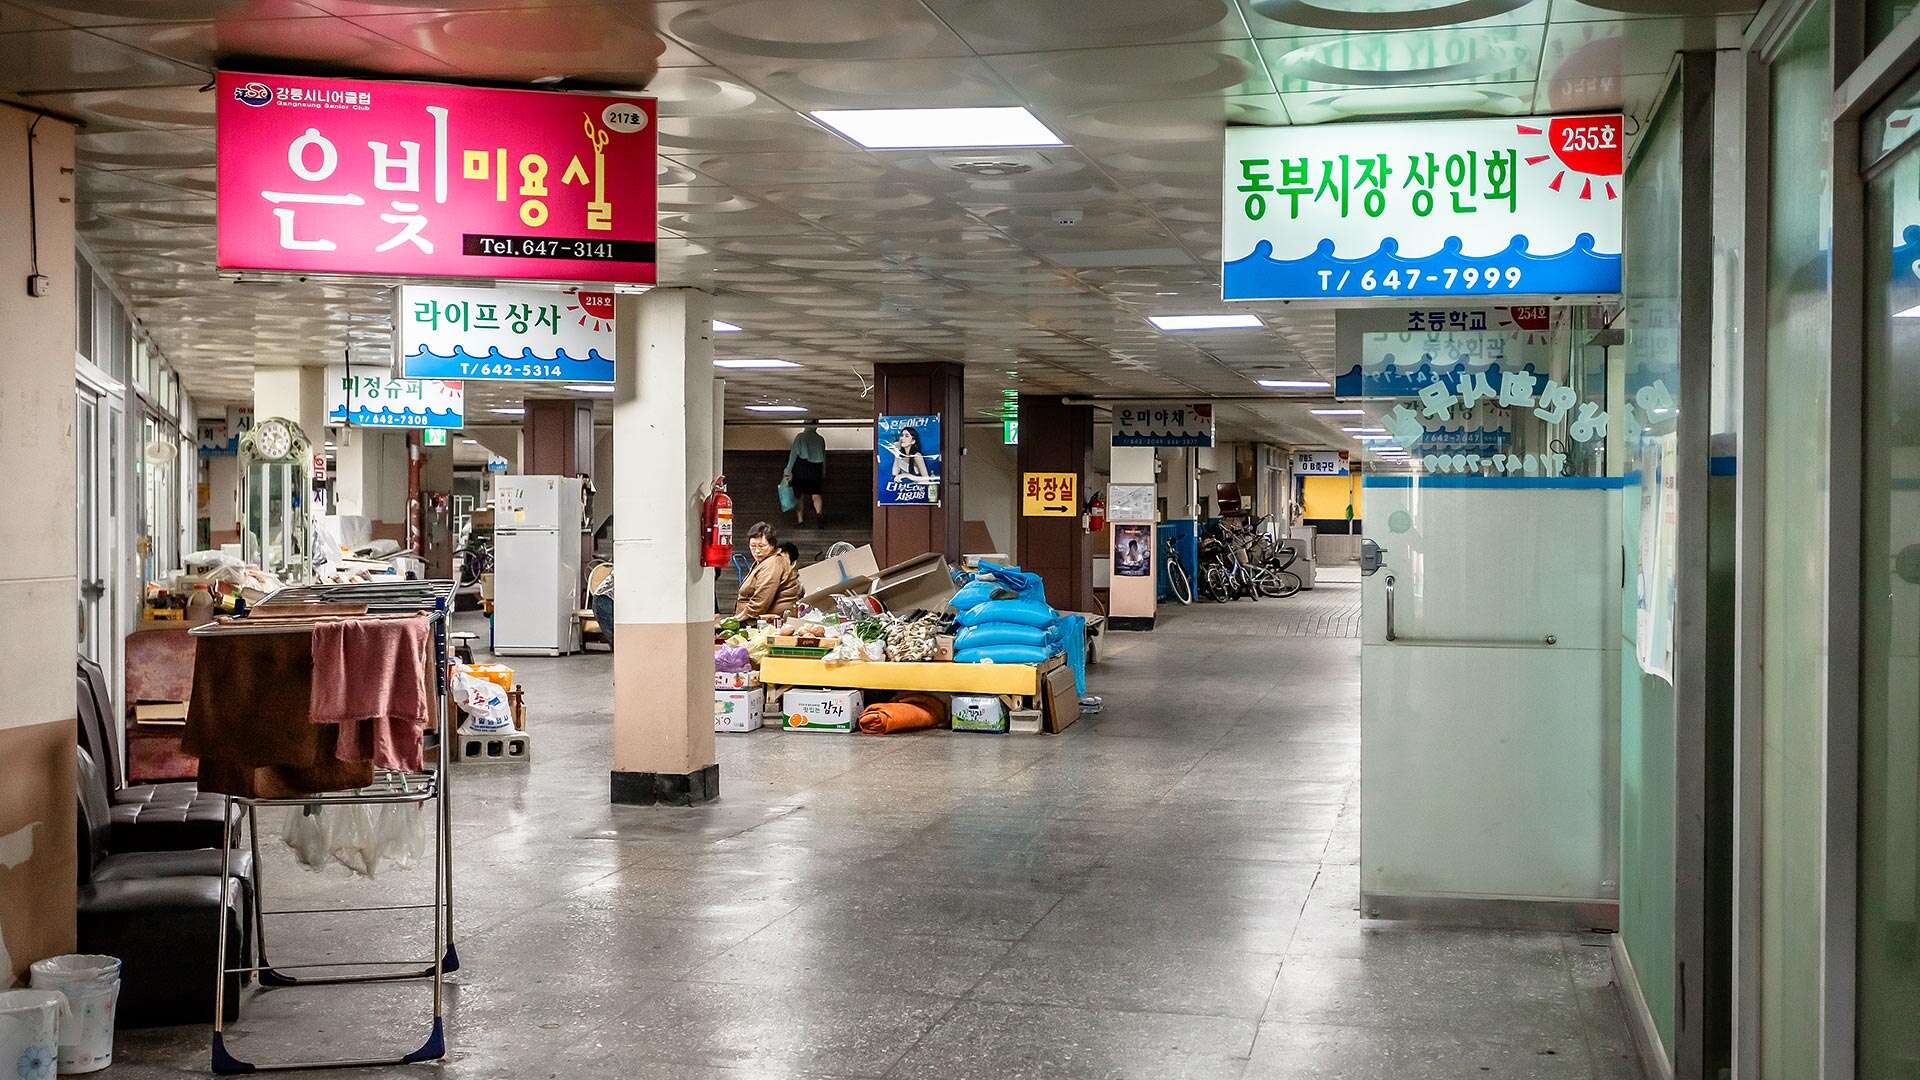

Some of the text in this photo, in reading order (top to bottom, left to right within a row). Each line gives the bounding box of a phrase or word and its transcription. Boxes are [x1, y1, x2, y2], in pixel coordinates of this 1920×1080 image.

[276, 87, 372, 105] 강릉시니어클럽
[609, 111, 641, 126] 217호
[1561, 126, 1617, 152] 255호
[260, 105, 613, 255] 은빛 미용실
[1236, 148, 1518, 221] 동부시장 상인회
[585, 295, 611, 307] 218호
[414, 300, 562, 336] 라이프상사
[1407, 310, 1487, 332] 초등학교
[1518, 307, 1547, 320] 254호
[460, 362, 562, 378] T/642-5314
[1119, 409, 1185, 427] 은미야채
[1026, 476, 1073, 503] 화장실
[821, 700, 844, 717] 감자
